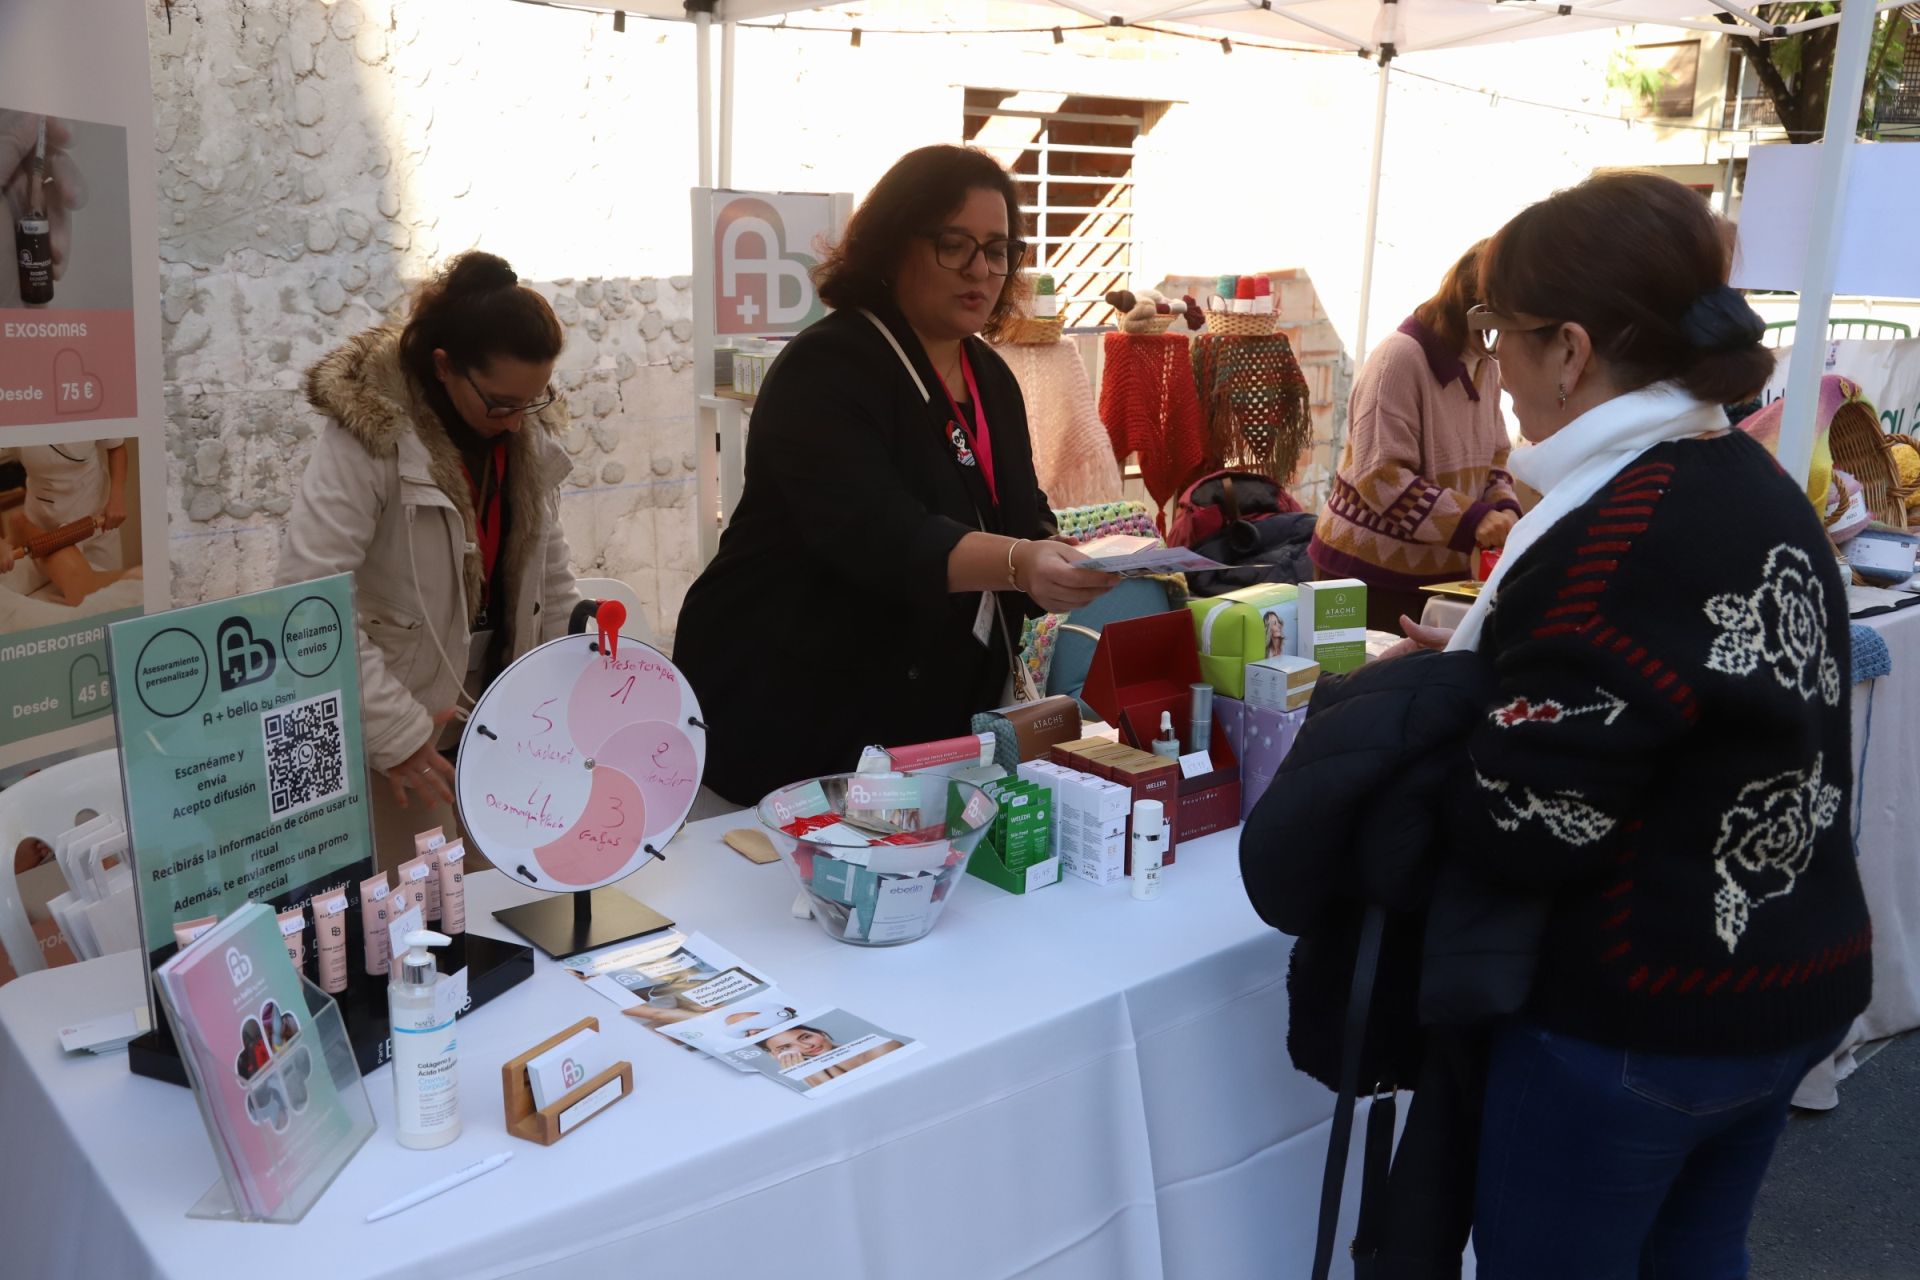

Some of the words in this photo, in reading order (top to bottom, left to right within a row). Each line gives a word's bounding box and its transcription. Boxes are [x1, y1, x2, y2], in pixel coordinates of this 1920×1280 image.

[4, 322, 88, 338] EXOSOMAS
[61, 382, 80, 400] 75
[1325, 606, 1357, 616] ATACHE
[1, 626, 105, 662] MADEROTERA
[286, 623, 338, 643] Realizamos
[142, 654, 200, 676] Asesoramiento
[145, 667, 199, 690] personalizado
[13, 697, 59, 719] Desde
[78, 684, 97, 703] 45
[610, 675, 636, 704] 1
[203, 711, 213, 727] A
[227, 701, 259, 719] bella
[261, 697, 273, 711] by
[275, 691, 296, 705] Asmi
[531, 697, 558, 737] 5
[1033, 714, 1064, 730] ATACHE
[174, 753, 235, 780] Escanéame
[237, 749, 245, 763] y
[651, 742, 669, 769] 2
[1145, 780, 1167, 790] WELEDA
[172, 798, 212, 820] Acepto
[213, 783, 256, 805] difusión
[601, 796, 625, 829] 3
[152, 853, 204, 882] Recibirás
[206, 849, 217, 860] la
[219, 824, 282, 857] información
[284, 818, 297, 830] de
[298, 807, 325, 825] cómo
[326, 801, 346, 816] usar
[348, 793, 359, 806] tu
[250, 843, 279, 863] ritual
[173, 886, 222, 913] Además,
[223, 879, 235, 892] te
[237, 856, 296, 886] enviaremos
[298, 847, 316, 860] una
[318, 832, 349, 854] promo
[248, 873, 289, 900] especial
[889, 883, 924, 895] eberlin
